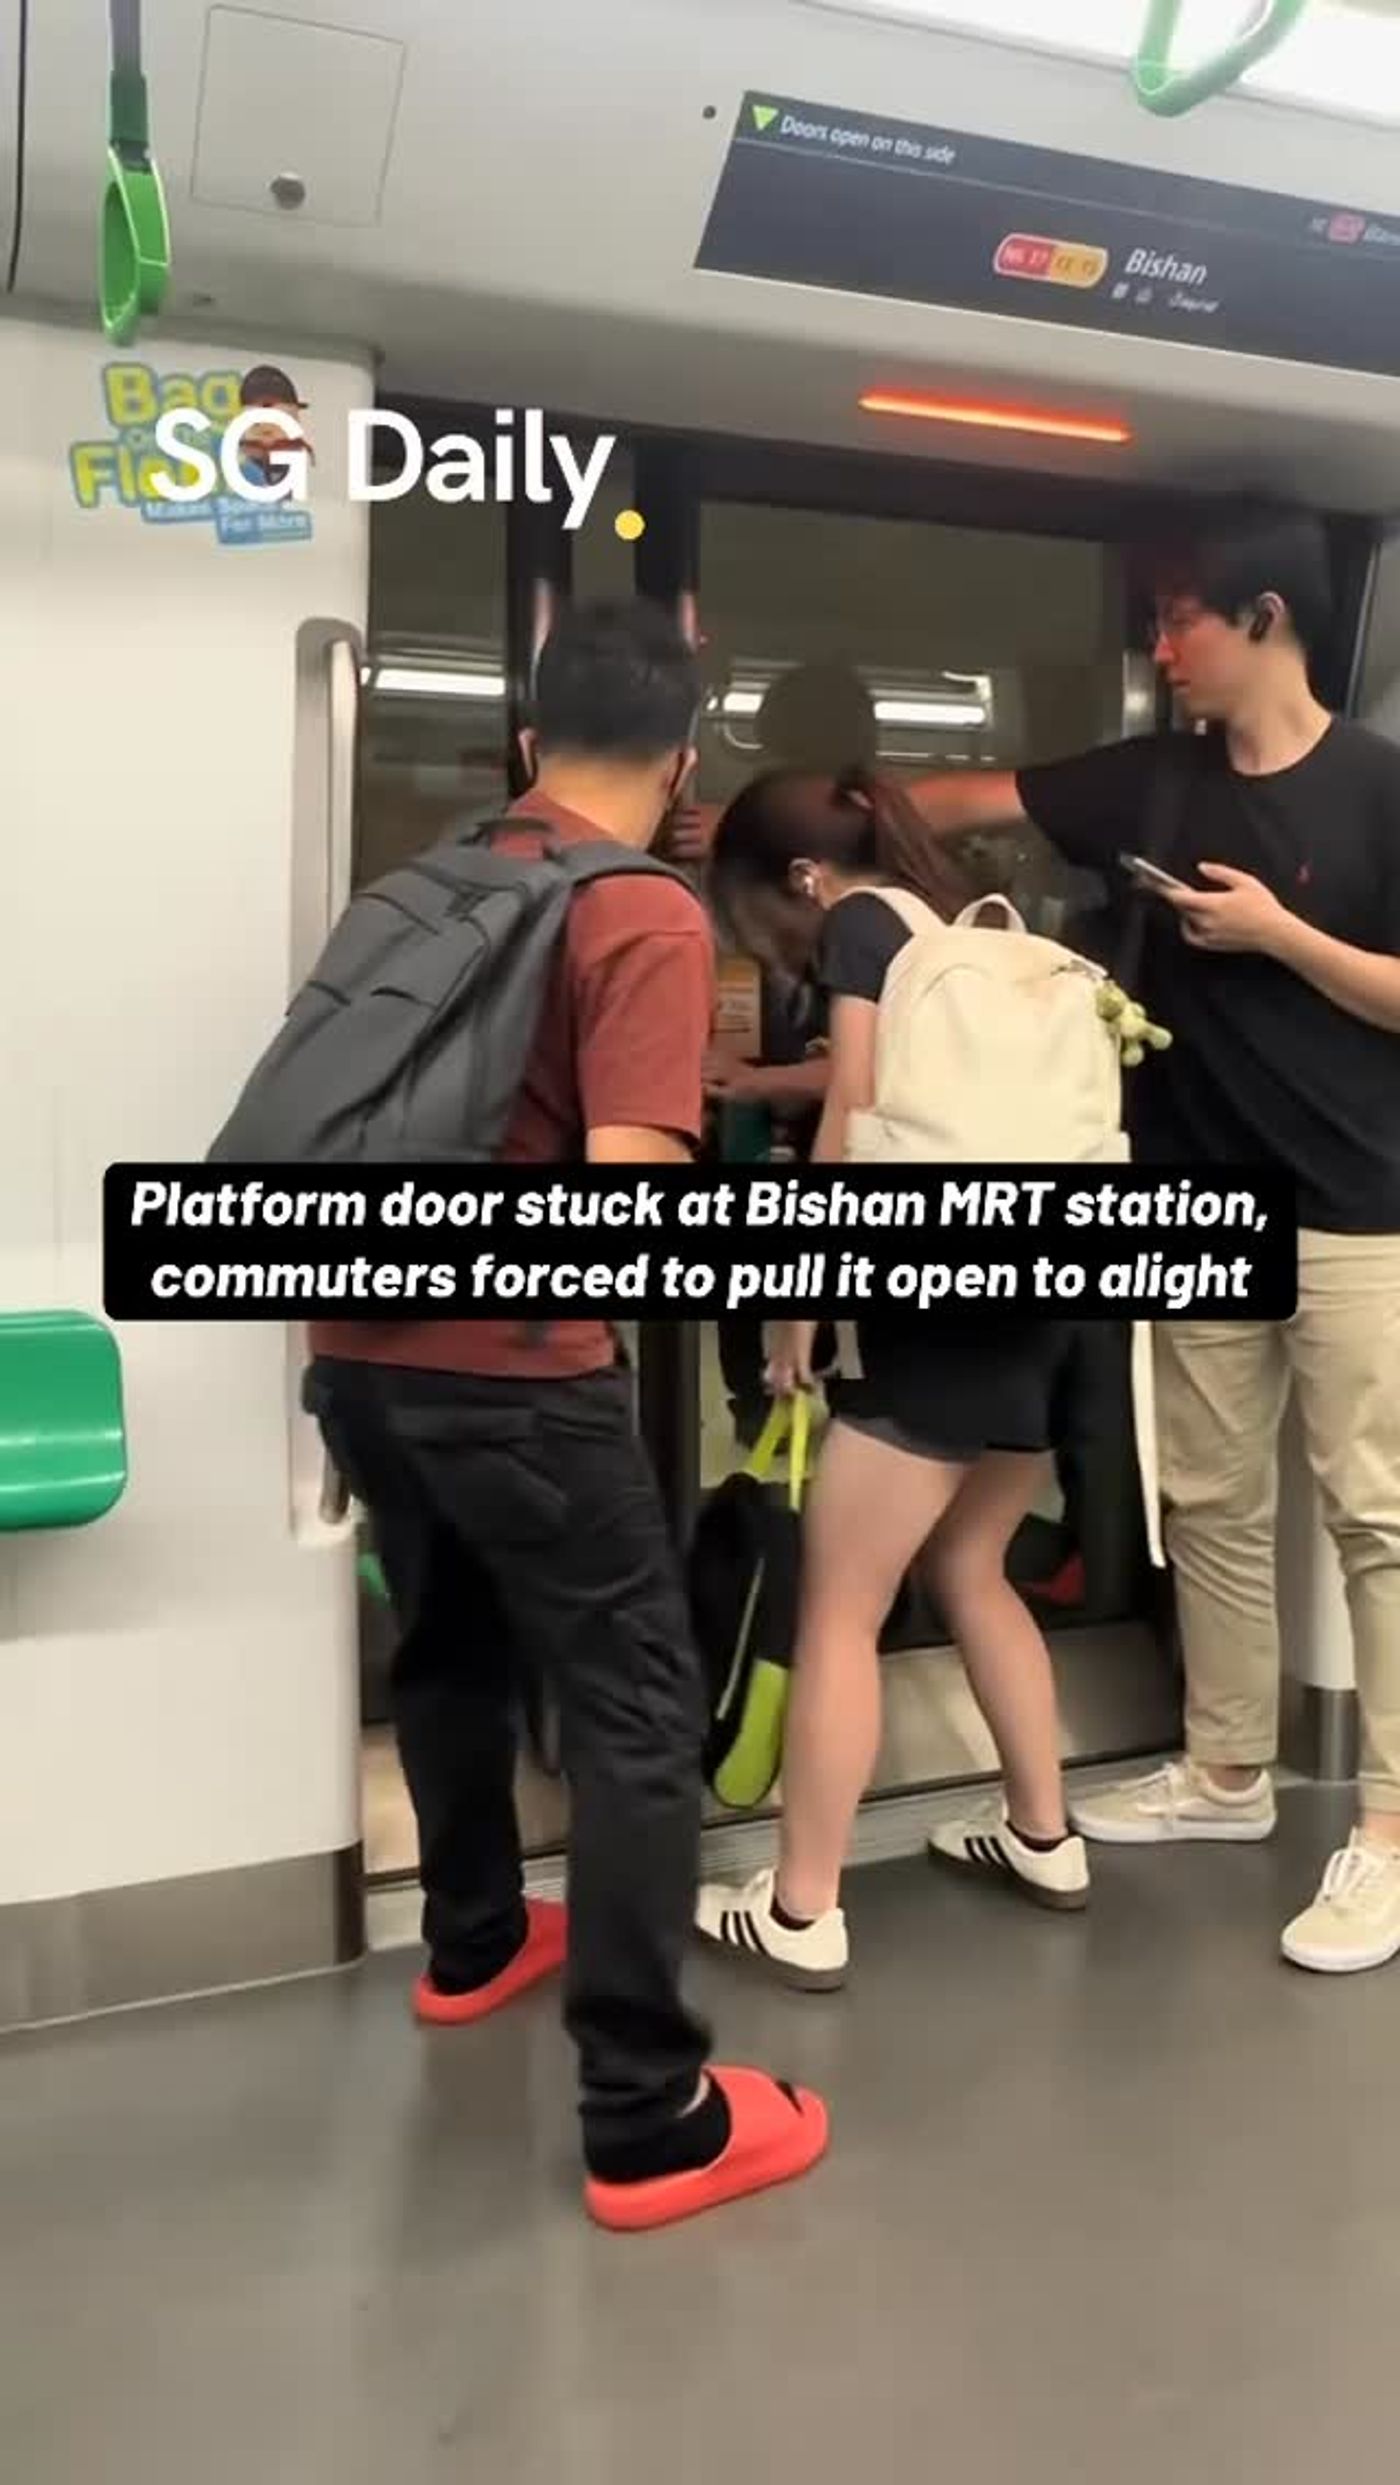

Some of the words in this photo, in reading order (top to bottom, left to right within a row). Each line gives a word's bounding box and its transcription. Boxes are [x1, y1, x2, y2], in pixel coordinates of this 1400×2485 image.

[780, 115, 828, 142] Doors
[829, 127, 870, 148] open
[870, 136, 893, 152] on
[894, 139, 923, 159] this
[924, 144, 956, 165] side
[1124, 246, 1208, 287] Bishan
